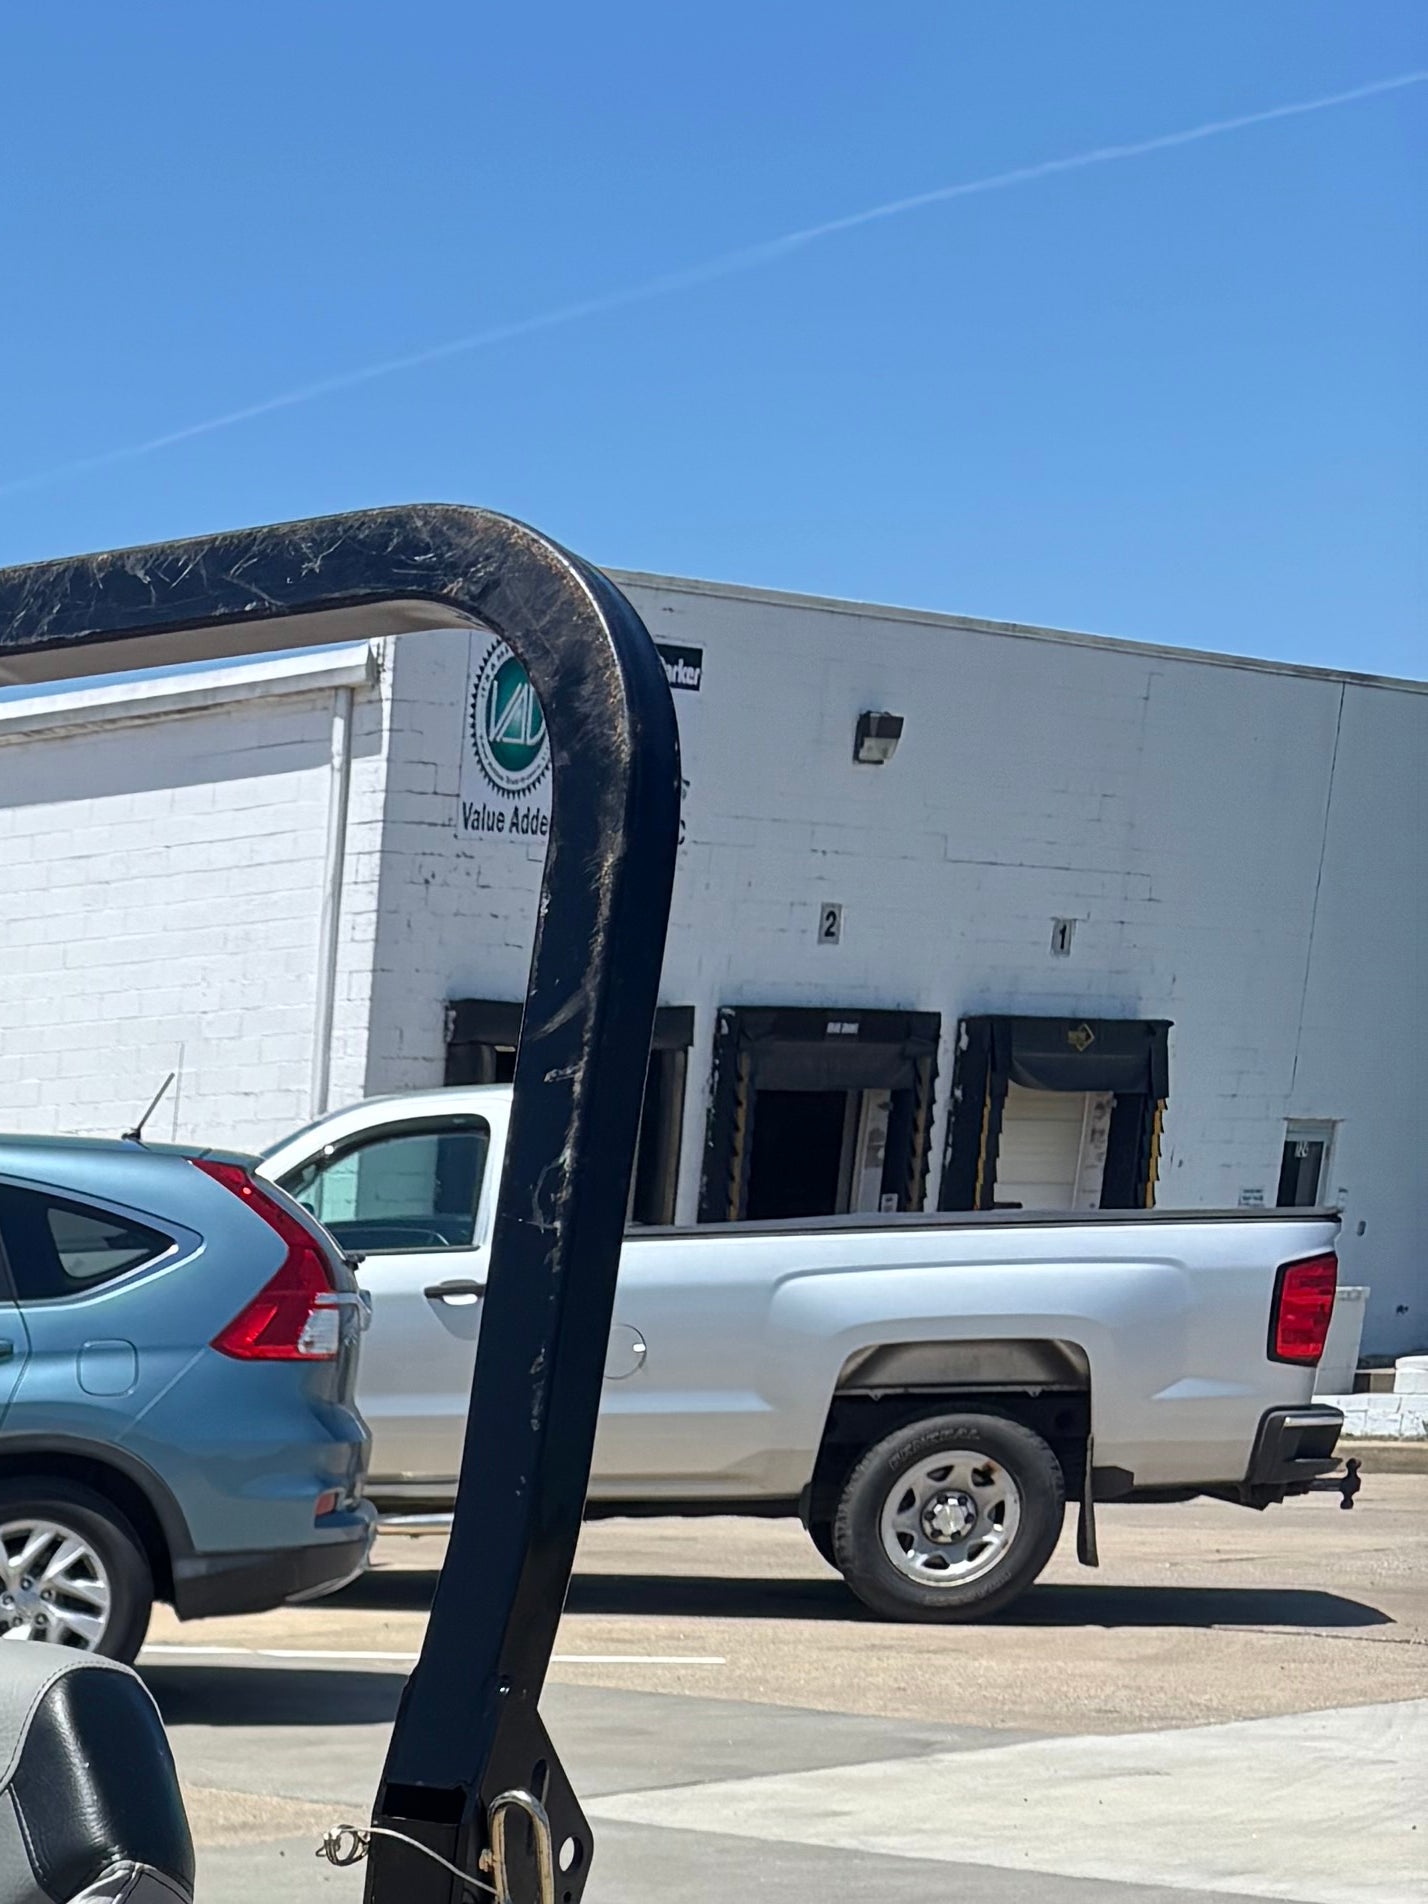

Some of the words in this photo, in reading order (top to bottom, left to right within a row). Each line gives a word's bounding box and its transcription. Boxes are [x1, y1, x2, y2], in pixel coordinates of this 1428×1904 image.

[662, 655, 702, 687] arker
[462, 801, 506, 833] Value
[508, 806, 550, 836] Adde
[824, 909, 839, 939] 2
[1058, 922, 1068, 951] 1
